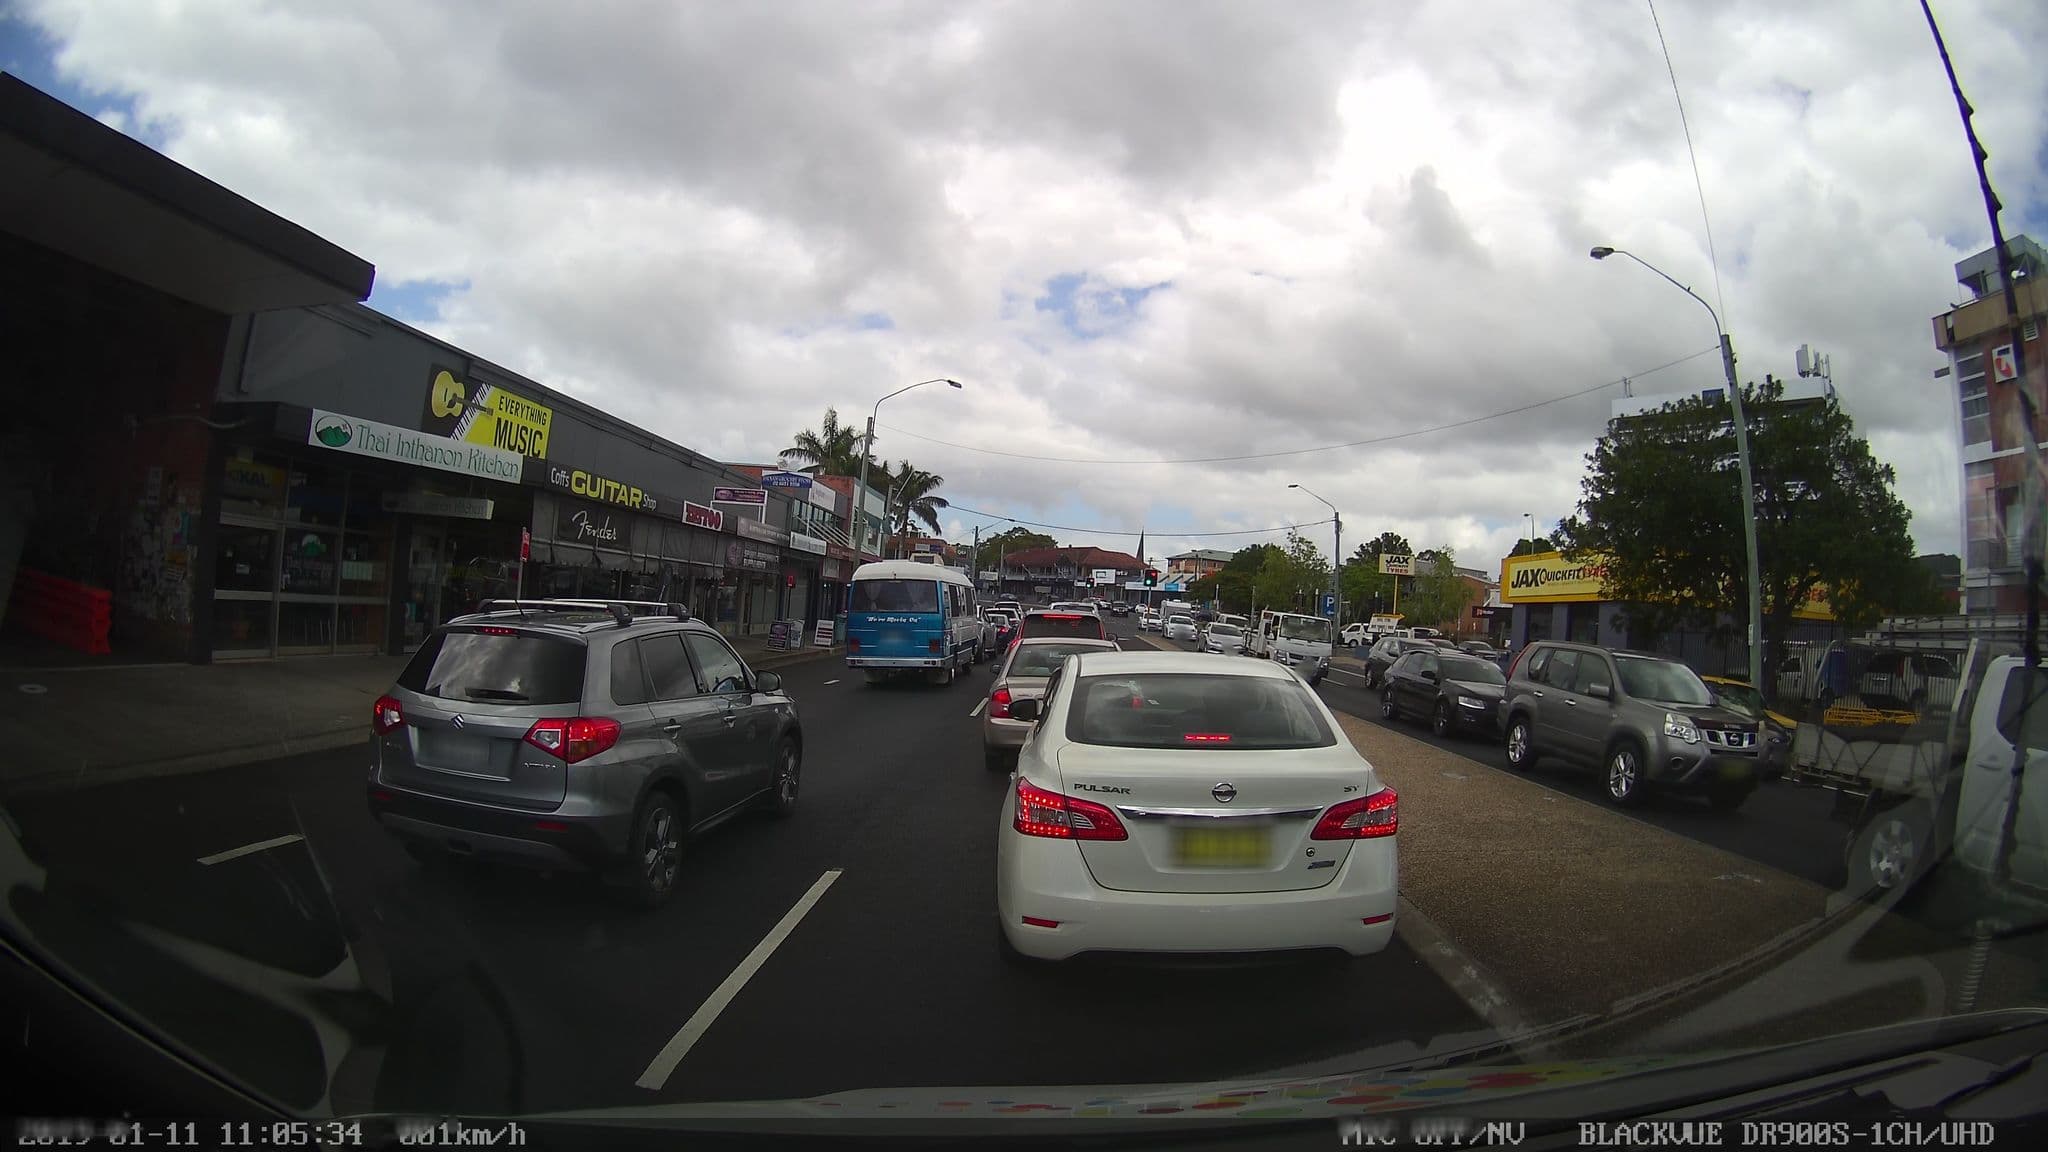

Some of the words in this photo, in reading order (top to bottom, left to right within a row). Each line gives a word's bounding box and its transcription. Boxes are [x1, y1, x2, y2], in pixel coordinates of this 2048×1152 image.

[499, 395, 547, 426] EVERYTHING
[356, 425, 390, 453] Thai
[397, 433, 463, 465] Inthanon
[468, 448, 520, 479] Kitchen
[494, 417, 543, 457] MUSIC
[550, 467, 569, 488] Coffs
[571, 470, 643, 509] GUITAR
[643, 493, 657, 511] Shop
[571, 510, 617, 540] Fender
[1386, 555, 1409, 565] JAX
[1511, 568, 1541, 588] JAX
[1539, 566, 1582, 585] QUICKFIT
[1326, 596, 1335, 608] P
[1074, 783, 1131, 794] PULSAR
